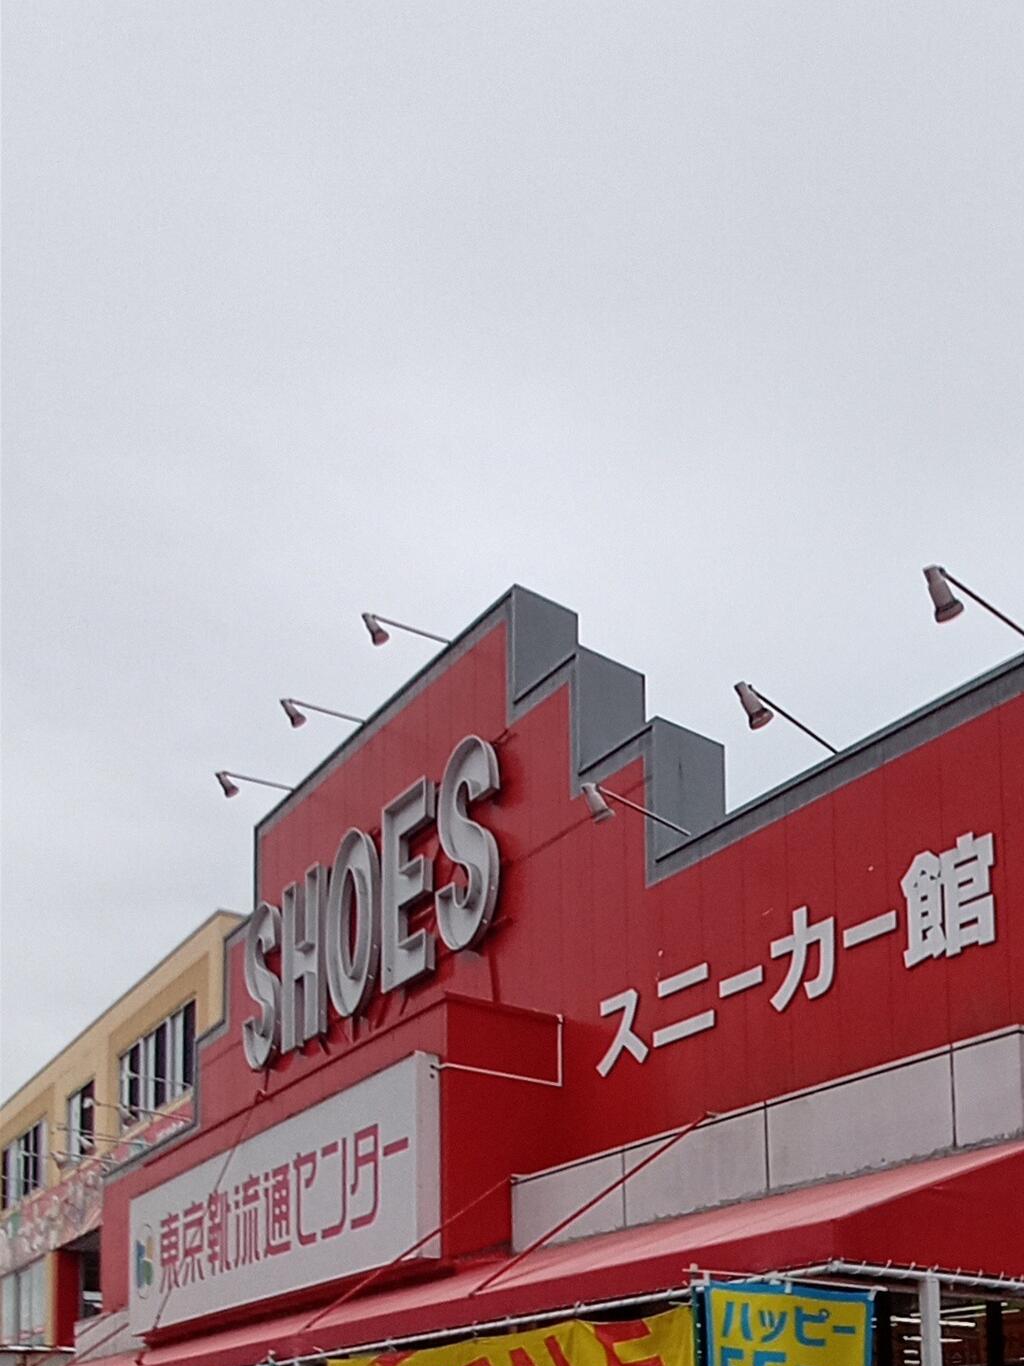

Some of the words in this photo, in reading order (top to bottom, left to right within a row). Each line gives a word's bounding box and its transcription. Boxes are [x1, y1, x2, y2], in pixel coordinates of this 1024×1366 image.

[243, 735, 499, 1070] SHOES
[596, 832, 995, 1077] スニーカー館
[159, 1123, 409, 1293] 東京靴流通センター
[722, 1301, 856, 1346] ハッピー
